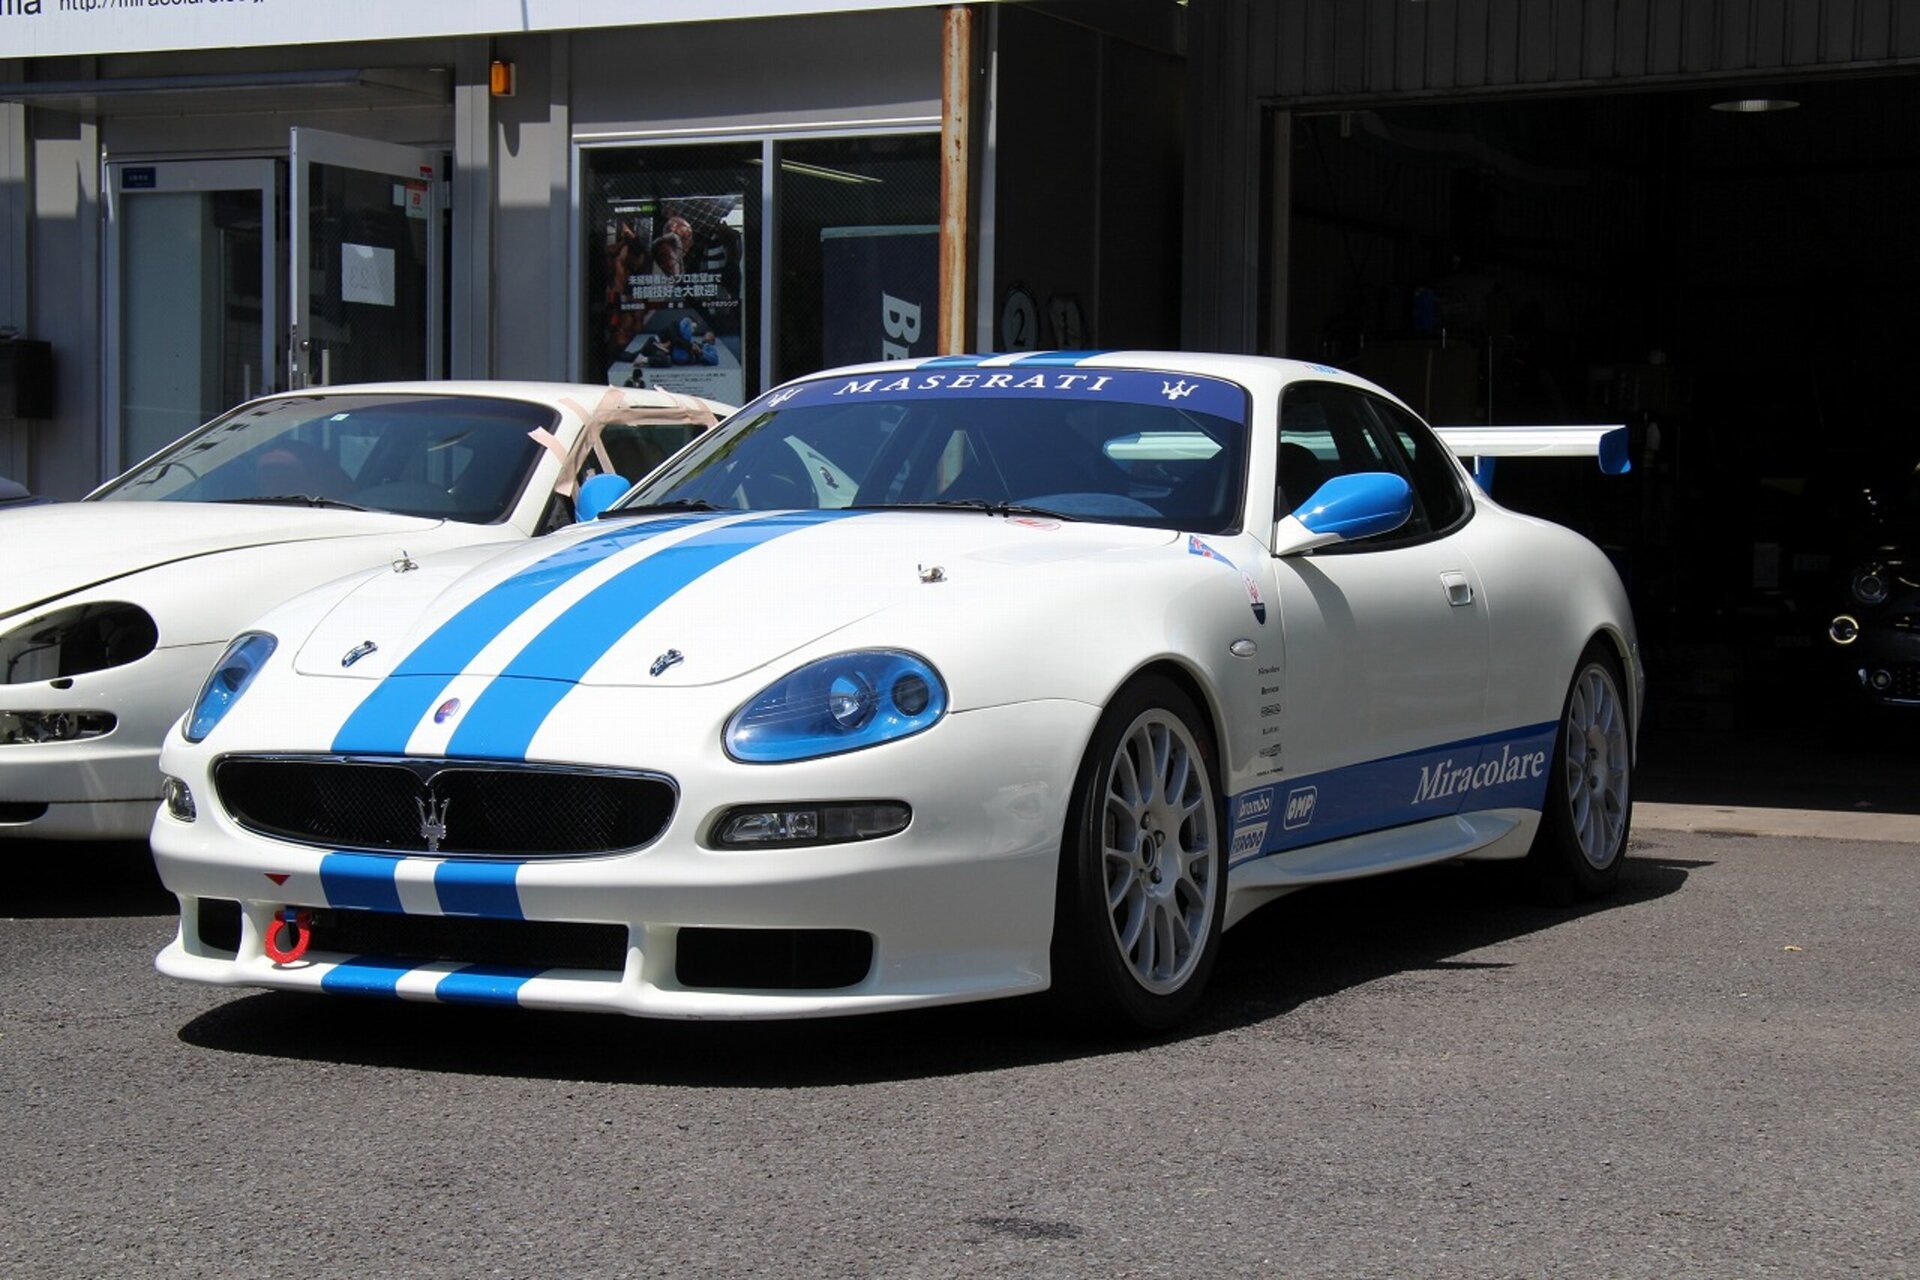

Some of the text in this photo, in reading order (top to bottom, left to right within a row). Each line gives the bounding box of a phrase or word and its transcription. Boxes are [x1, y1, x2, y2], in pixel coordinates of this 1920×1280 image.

[833, 374, 1113, 396] MASERATI
[1410, 743, 1546, 805] Miracolare
[1287, 793, 1315, 820] OMP
